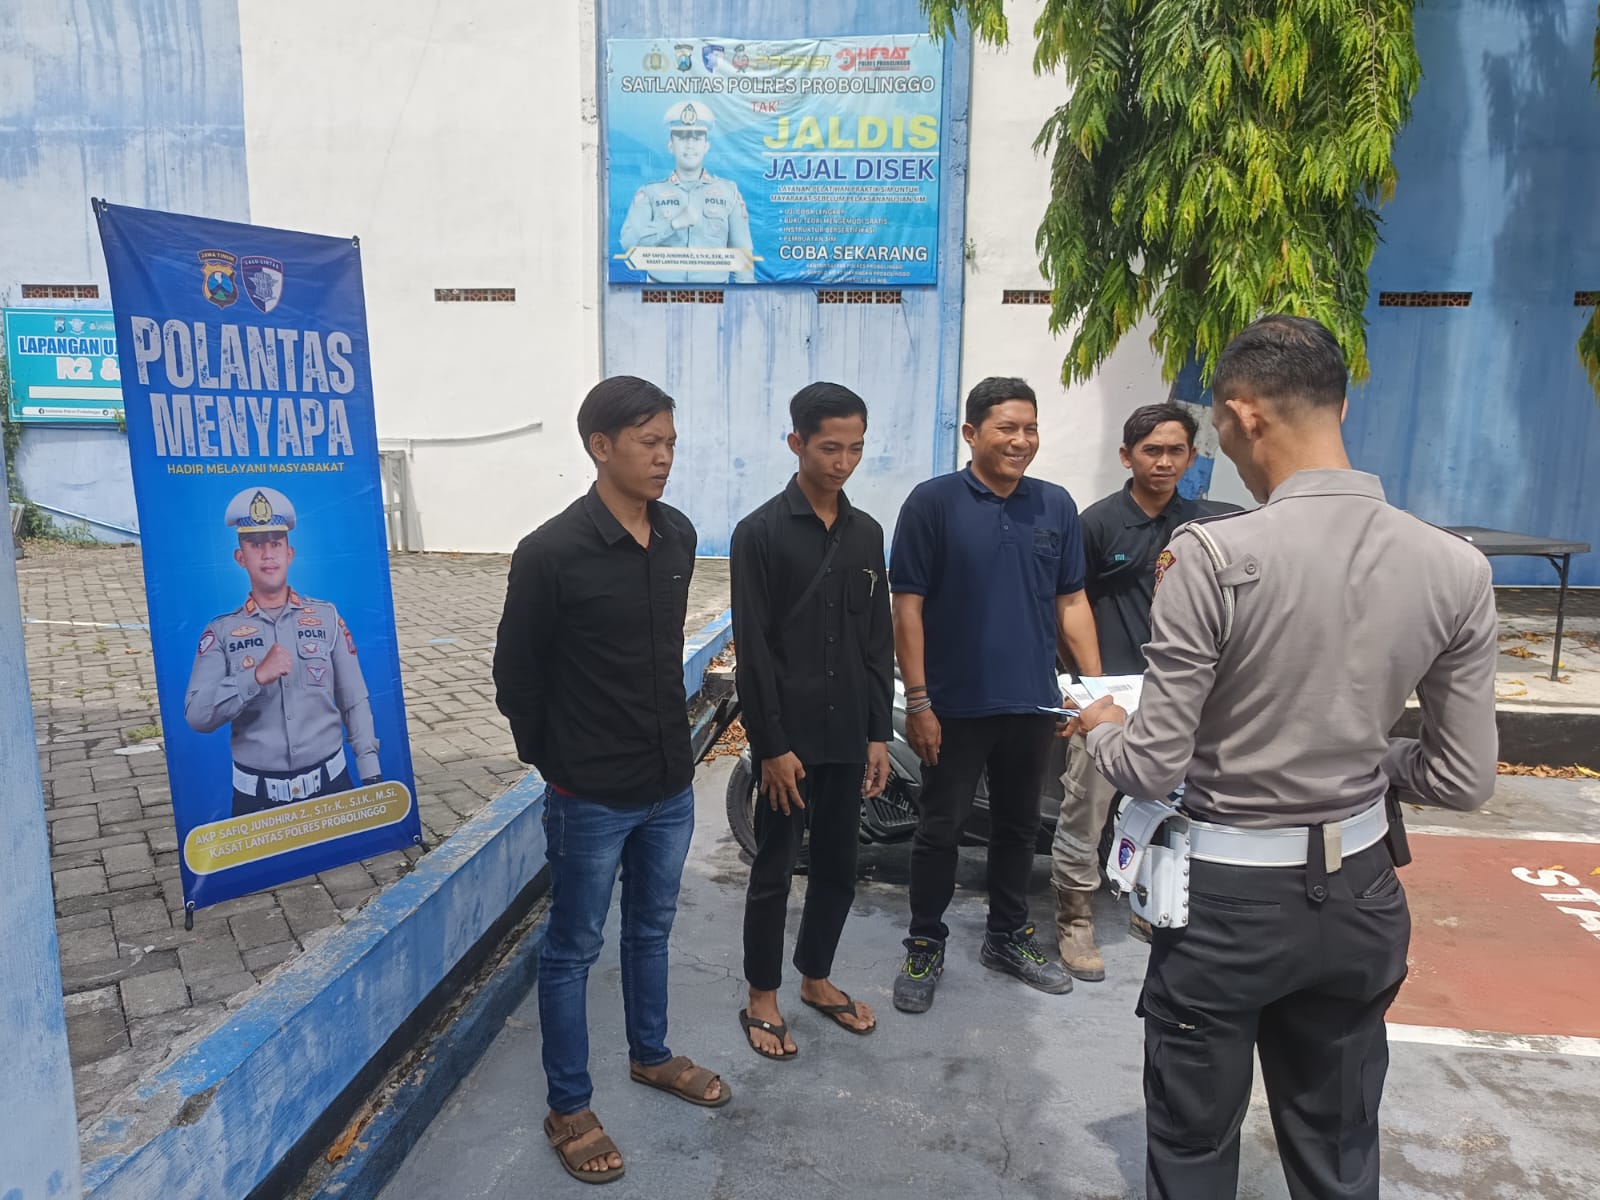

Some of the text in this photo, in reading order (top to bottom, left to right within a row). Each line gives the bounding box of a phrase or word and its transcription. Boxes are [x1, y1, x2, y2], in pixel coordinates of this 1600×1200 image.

[622, 76, 935, 93] SATLANTAS POLRES PROBOLINGGO
[763, 115, 938, 150] JALDIS
[762, 158, 935, 181] JAJAL DISEK
[655, 199, 681, 207] SAFIQ
[704, 198, 727, 206] POLRI
[779, 245, 929, 262] COBA SEKARANG
[18, 336, 101, 356] LAPANGAN
[131, 316, 356, 394] POLANTAS
[56, 356, 94, 380] R2
[150, 393, 355, 457] MENYAPA
[167, 462, 345, 474] HADIR MELAYANI MASYARAKAT
[298, 629, 326, 640] POLRI
[229, 638, 264, 652] SAFIQ
[195, 832, 217, 846] AKP
[219, 824, 249, 843] SAFIQ
[250, 812, 298, 833] JUNDHIRA
[209, 805, 387, 859] KASAT LANTAS POLRES PROBOLINGGO
